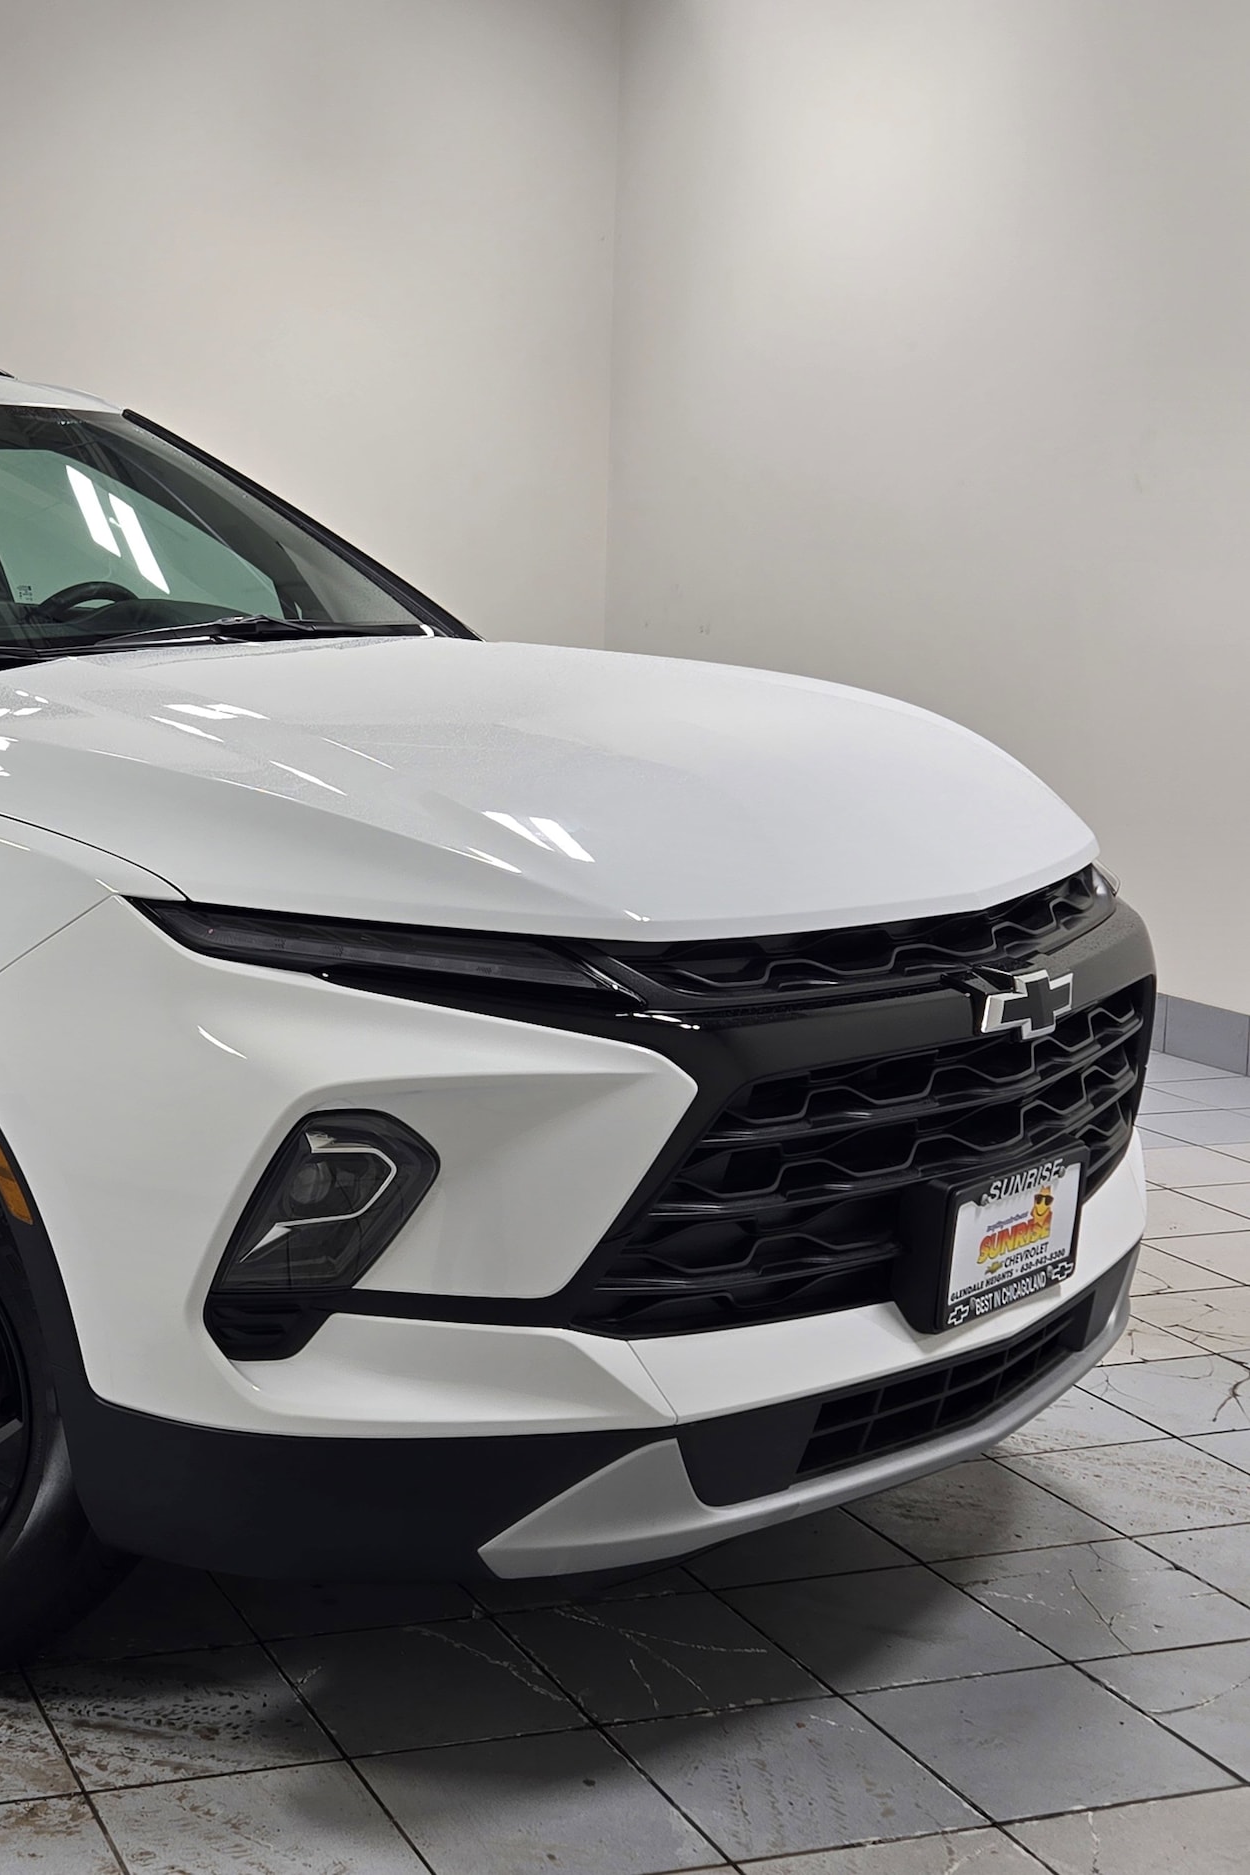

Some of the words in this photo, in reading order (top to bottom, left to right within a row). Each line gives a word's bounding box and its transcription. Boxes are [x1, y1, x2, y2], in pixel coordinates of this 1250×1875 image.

[988, 1158, 1063, 1201] SUNRISE
[976, 1219, 1052, 1264] SUNRISE
[1004, 1242, 1049, 1268] CHEVROLET
[950, 1280, 985, 1302] GLENDALE
[985, 1269, 1014, 1288] HEIGHTS
[975, 1293, 993, 1315] BEST
[993, 1289, 1002, 1309] IN
[1001, 1271, 1047, 1305] CHICAGOLAND
